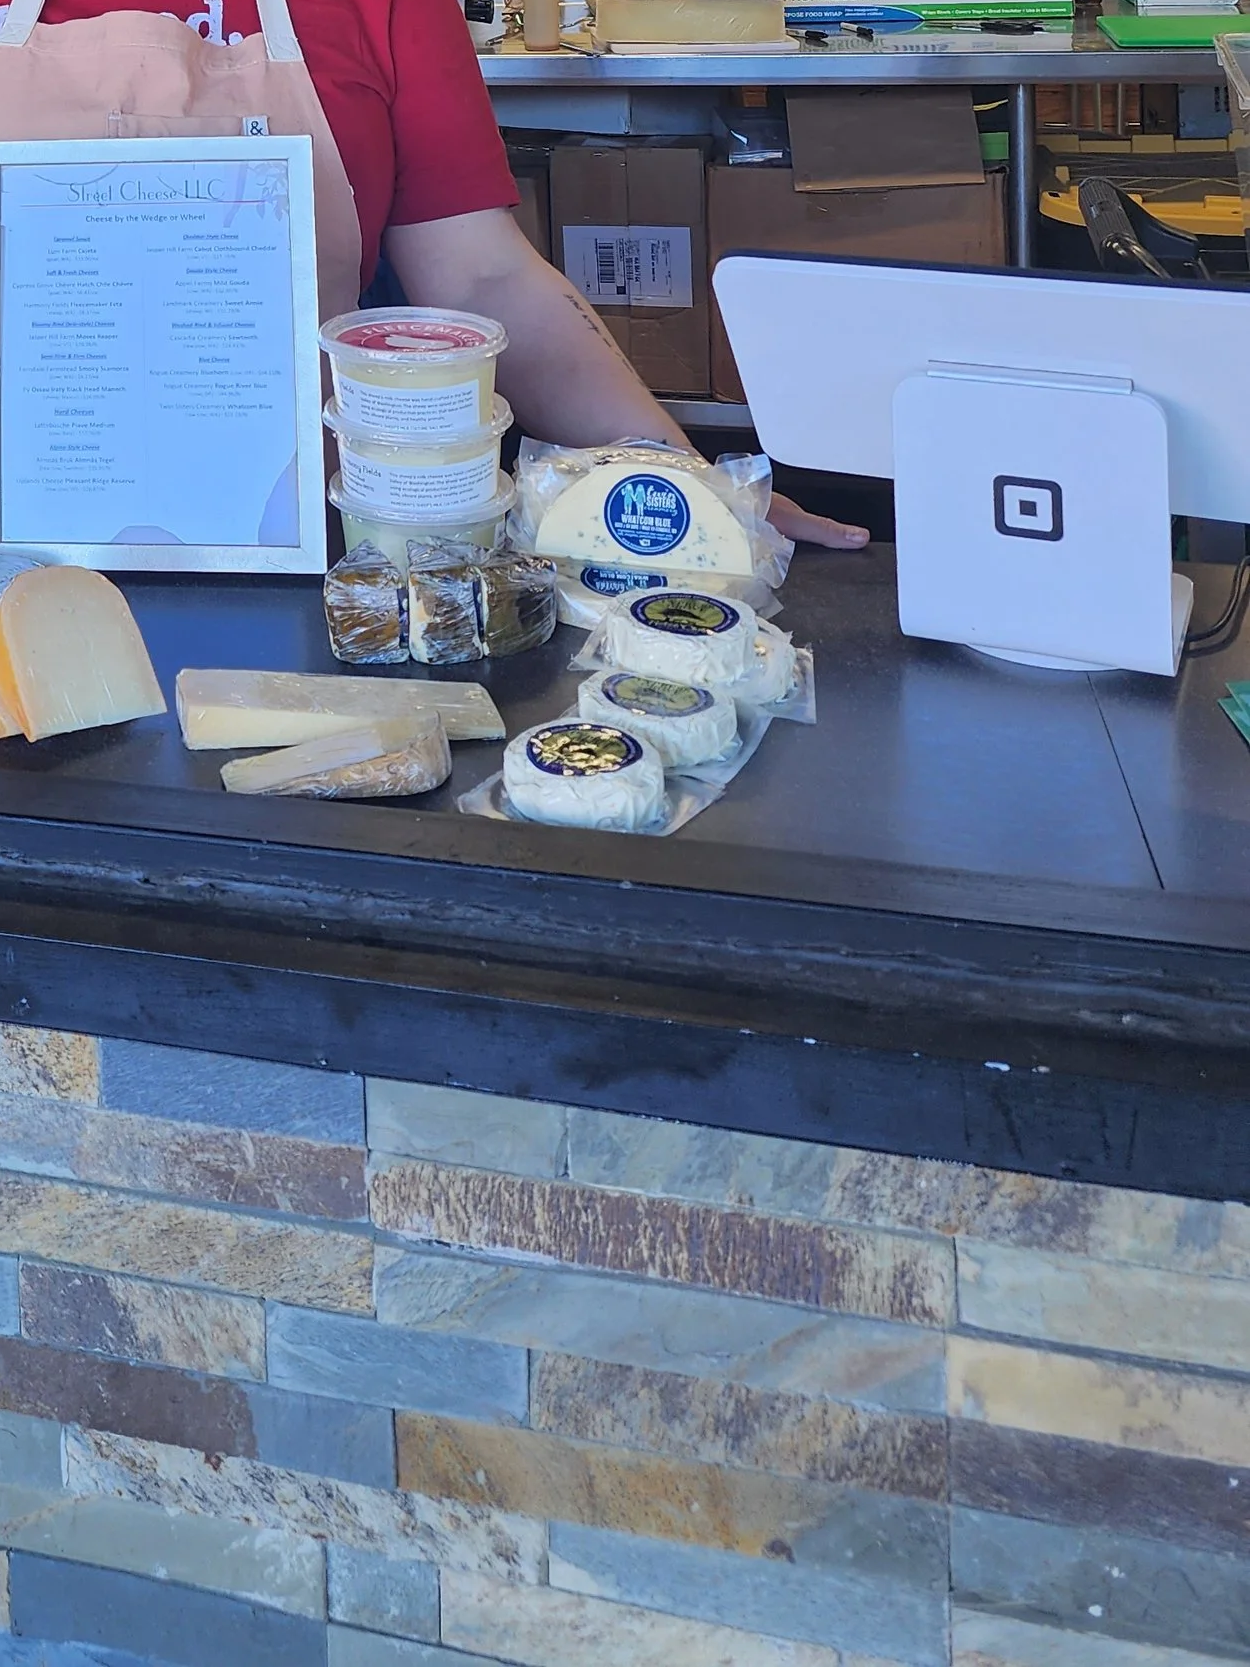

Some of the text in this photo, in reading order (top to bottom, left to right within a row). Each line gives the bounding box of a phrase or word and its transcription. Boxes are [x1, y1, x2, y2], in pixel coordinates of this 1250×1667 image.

[250, 121, 264, 136] &
[67, 179, 226, 203] Street Cheese LLC
[85, 214, 113, 222] Cheese
[114, 214, 125, 223] by
[126, 214, 139, 222] the
[140, 213, 168, 223] Wedge
[180, 213, 206, 221] Wheel
[362, 465, 382, 478] Fields
[646, 496, 677, 509] SISTERS
[621, 514, 672, 527] WHATCOM BLUE
